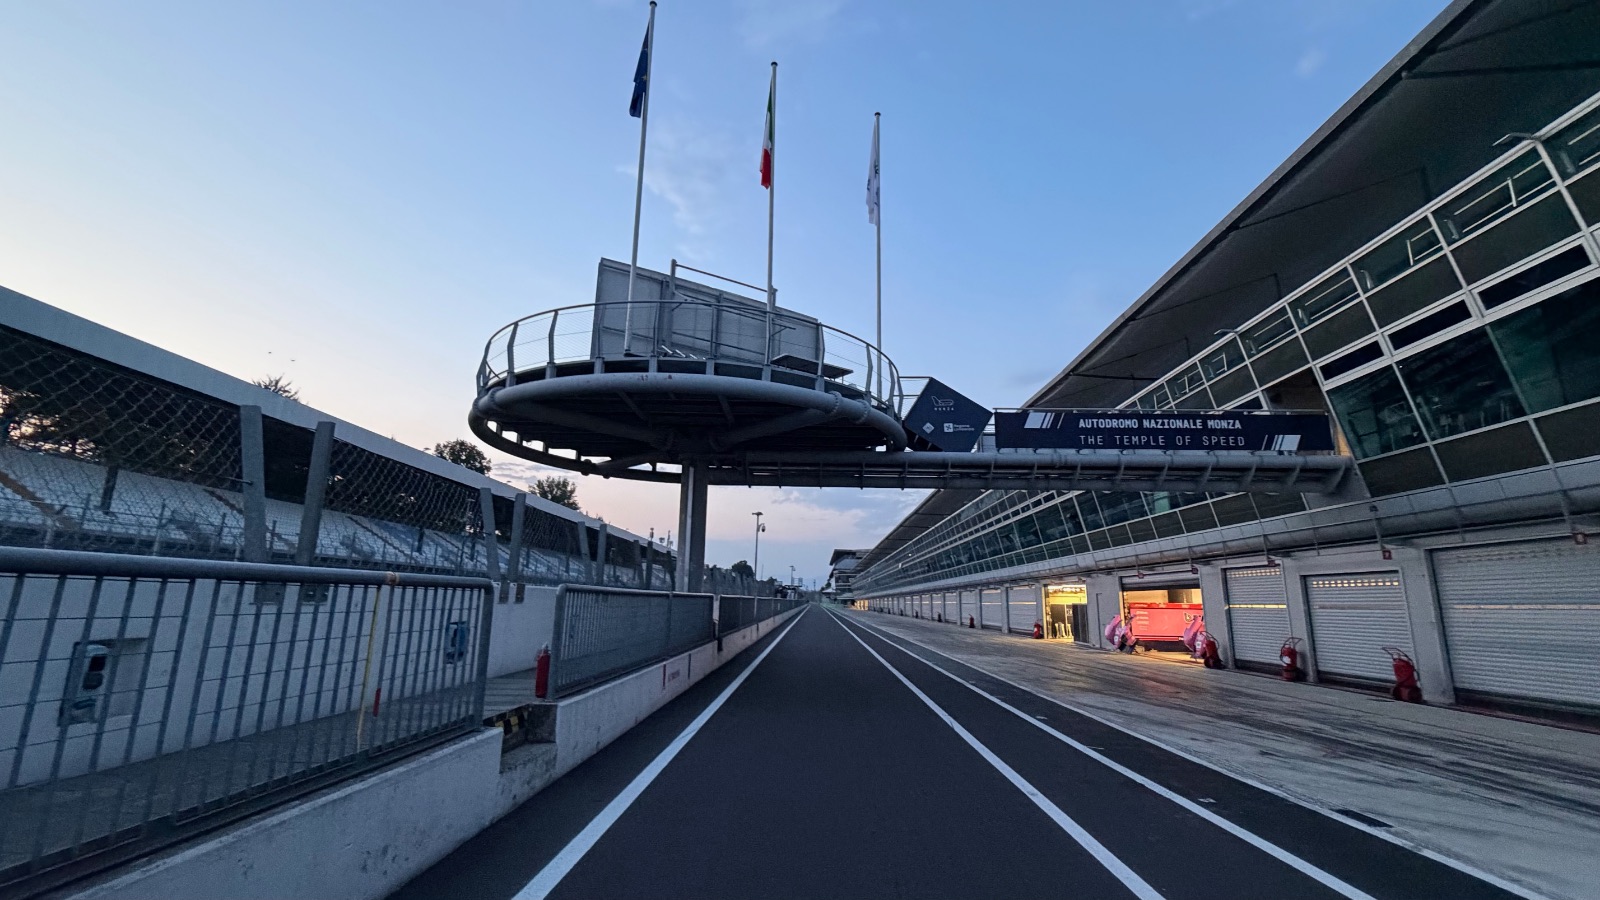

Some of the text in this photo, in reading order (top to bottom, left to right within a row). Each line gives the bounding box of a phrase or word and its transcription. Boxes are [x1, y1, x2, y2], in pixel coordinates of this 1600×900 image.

[1079, 419, 1242, 429] AUTODROMO NAZIONALE MONZA
[1079, 435, 1245, 446] THE TEMPLE OF SPEED
